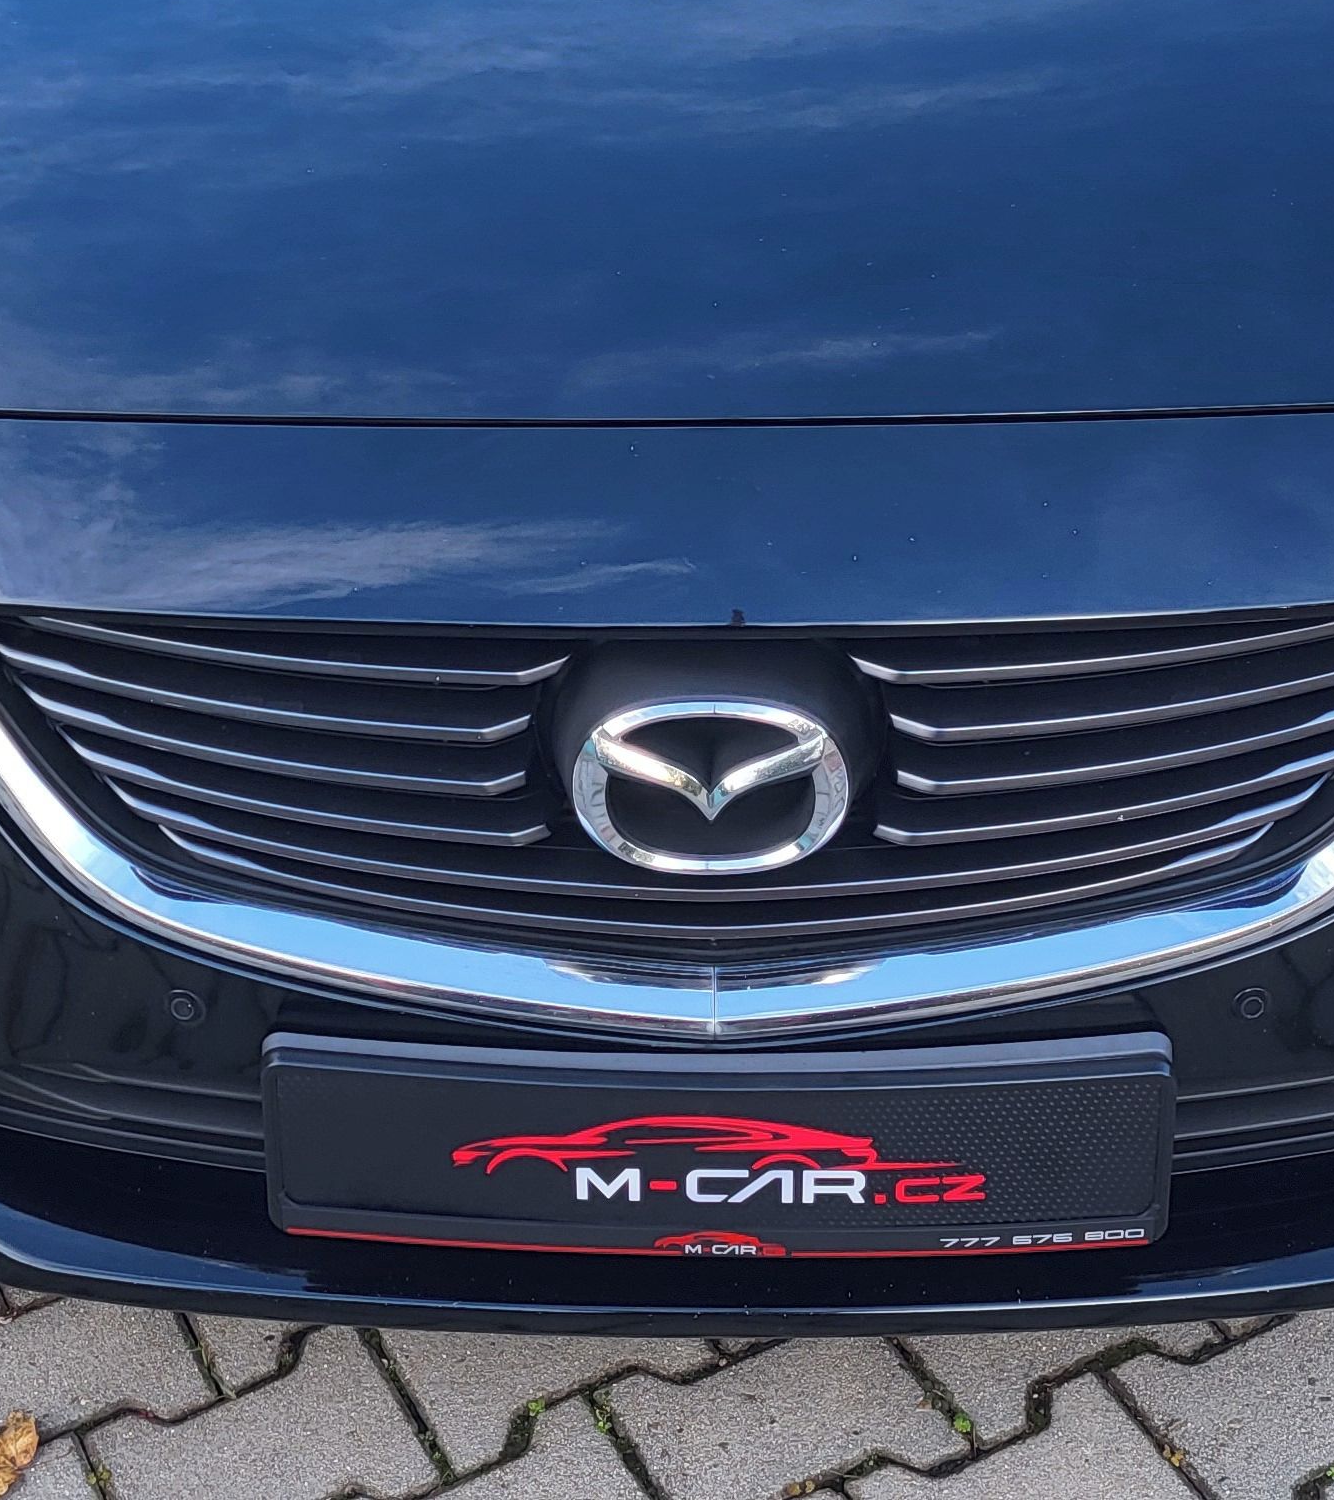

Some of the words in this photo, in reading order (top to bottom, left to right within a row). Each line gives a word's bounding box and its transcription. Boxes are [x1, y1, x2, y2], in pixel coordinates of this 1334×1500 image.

[939, 1236, 1001, 1248] 777
[1012, 1233, 1073, 1245] 676
[1084, 1228, 1145, 1241] 800
